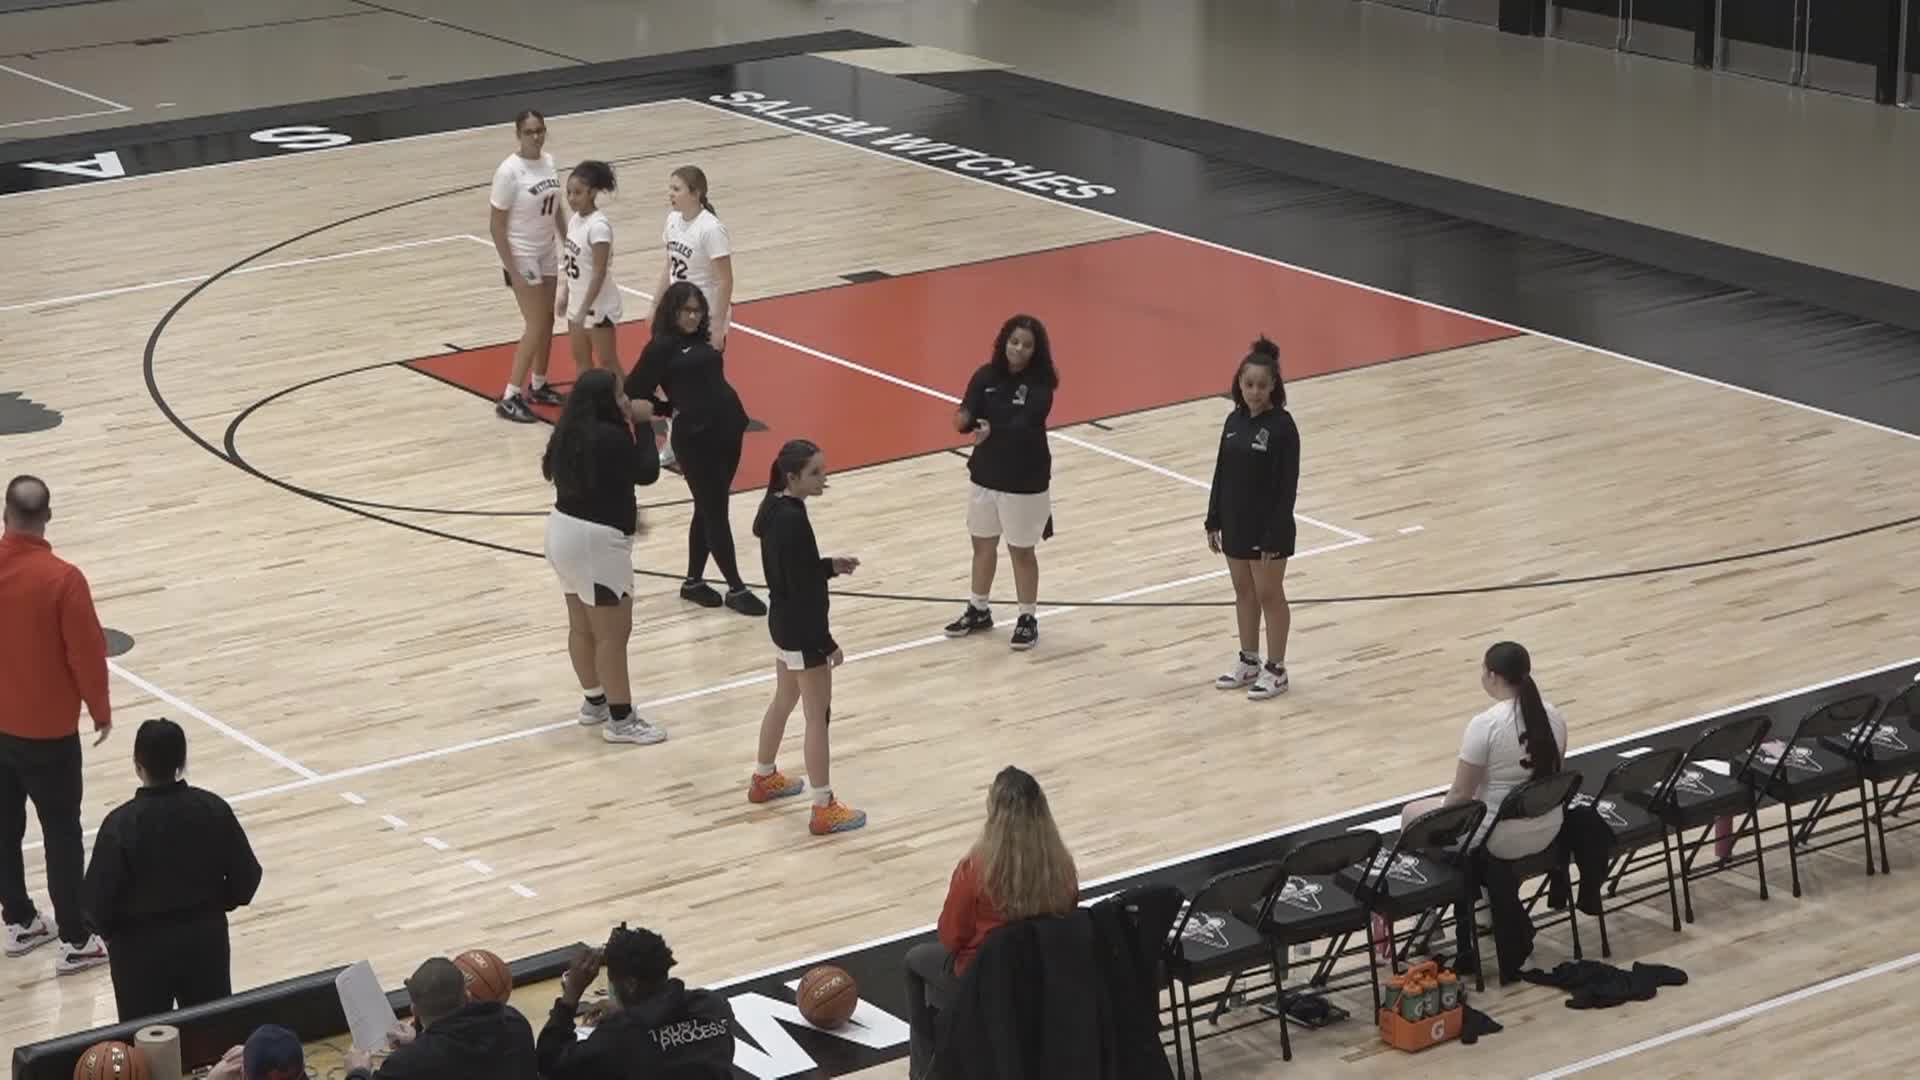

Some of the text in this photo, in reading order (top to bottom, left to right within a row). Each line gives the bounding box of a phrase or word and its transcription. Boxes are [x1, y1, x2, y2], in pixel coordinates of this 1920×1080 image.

[709, 91, 1117, 200] SALEM WITCHES
[541, 193, 555, 216] 11
[1430, 1020, 1445, 1041] G
